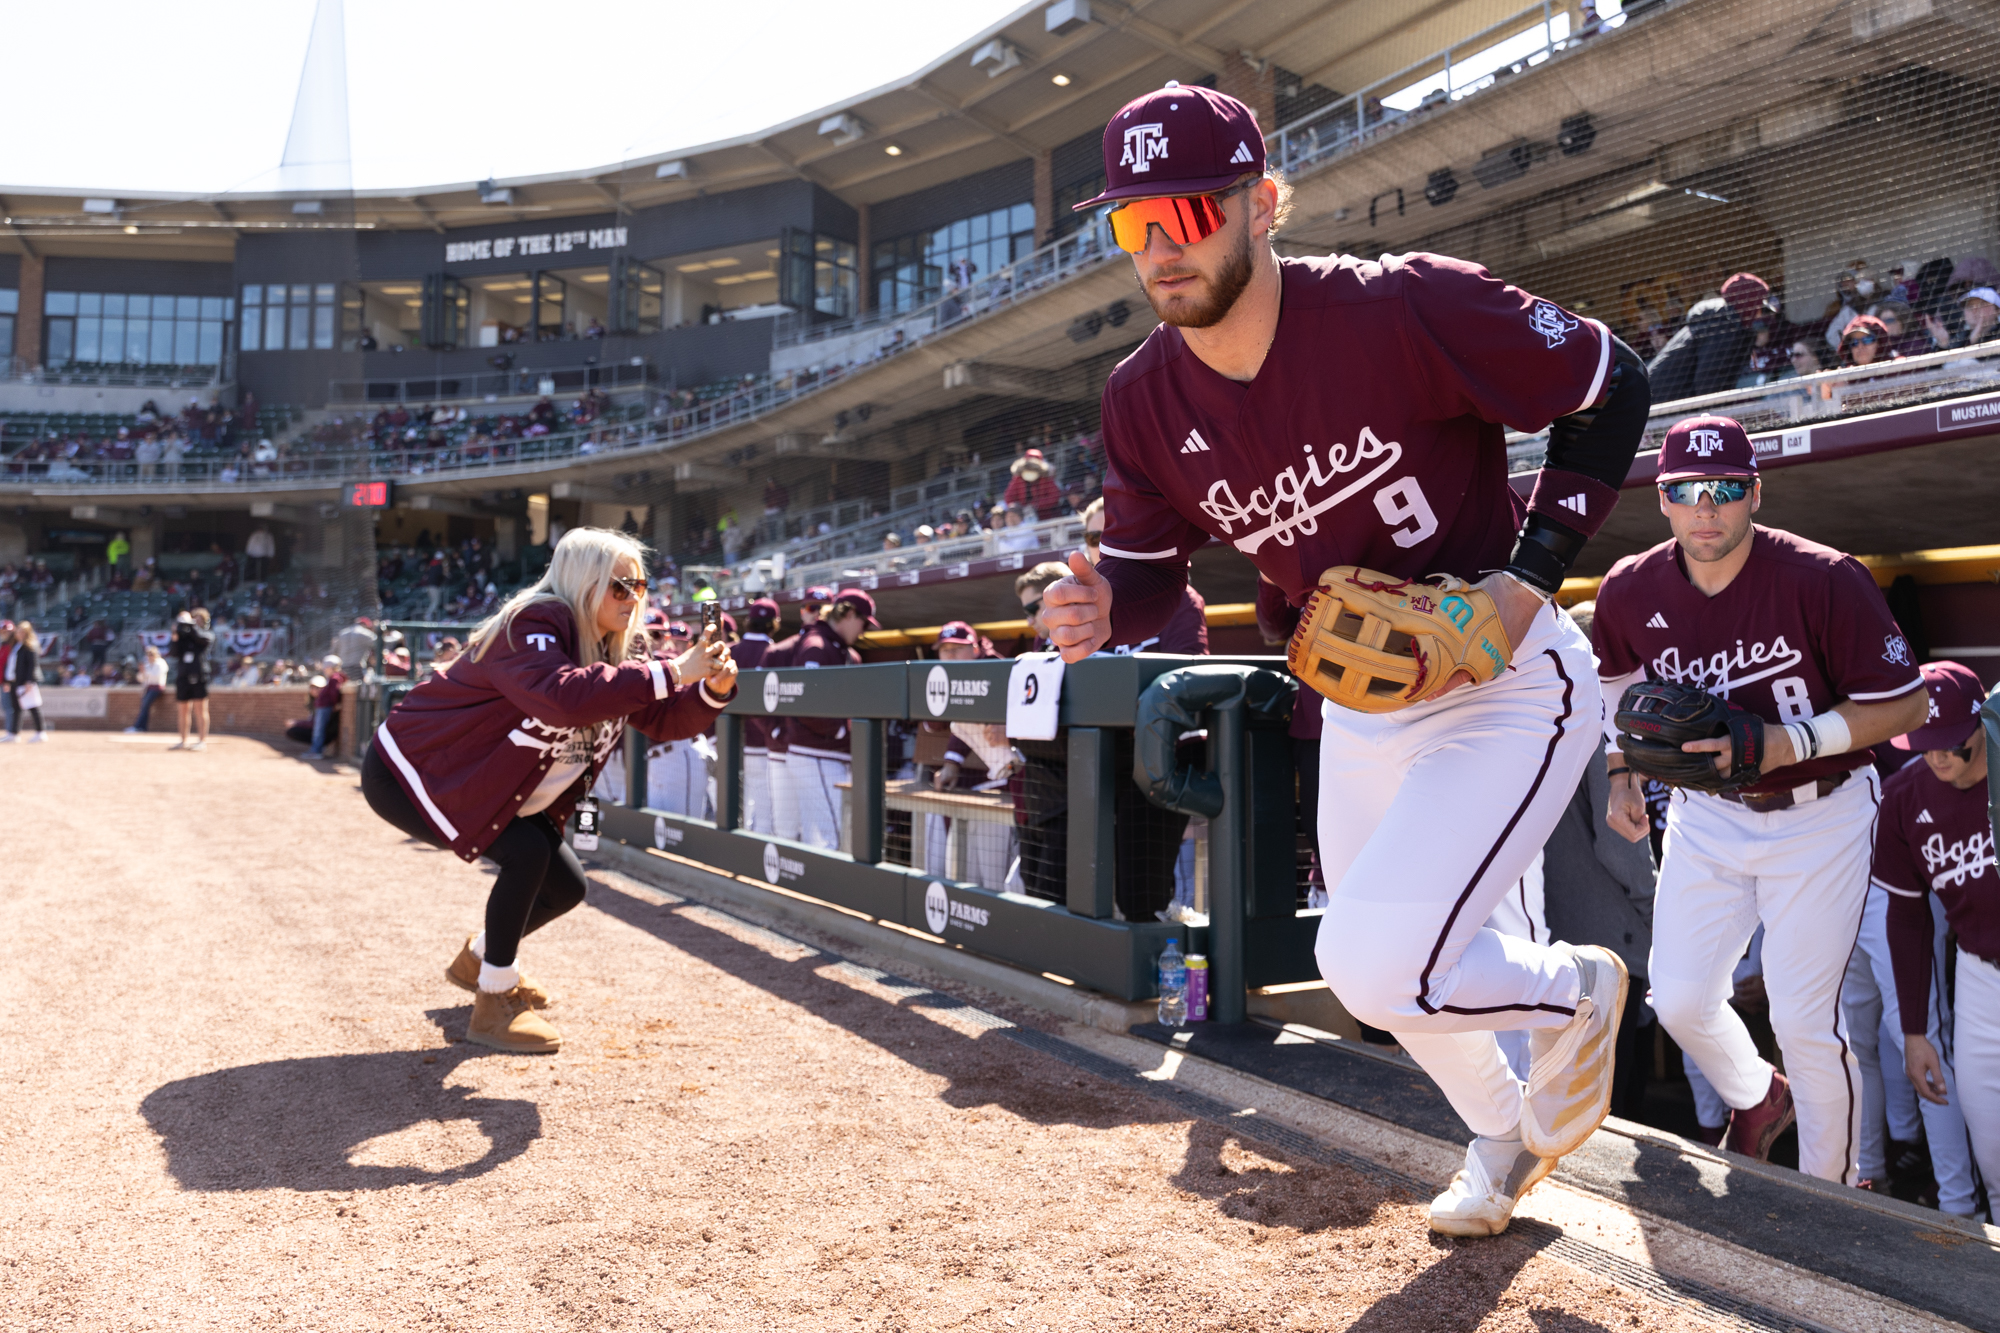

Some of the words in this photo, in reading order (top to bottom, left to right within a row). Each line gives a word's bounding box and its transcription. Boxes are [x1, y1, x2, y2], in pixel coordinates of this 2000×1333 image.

[445, 239, 492, 263] HOME
[493, 237, 516, 258] OF
[517, 234, 552, 255] THE
[554, 230, 587, 253] 12TH
[588, 226, 628, 249] MAN
[1951, 401, 2000, 422] MUSTAN
[1753, 439, 1779, 454] TANG
[1787, 436, 1803, 449] CAT
[1199, 426, 1403, 554] Aggies
[1373, 476, 1439, 549] 9
[1480, 635, 1506, 679] ilson
[1652, 635, 1802, 700] Aggies
[950, 680, 990, 697] FARMS
[1771, 676, 1814, 725] 8
[1628, 720, 1661, 733] A2000
[1743, 723, 1755, 764] Wilson
[950, 900, 988, 927] FARMS
